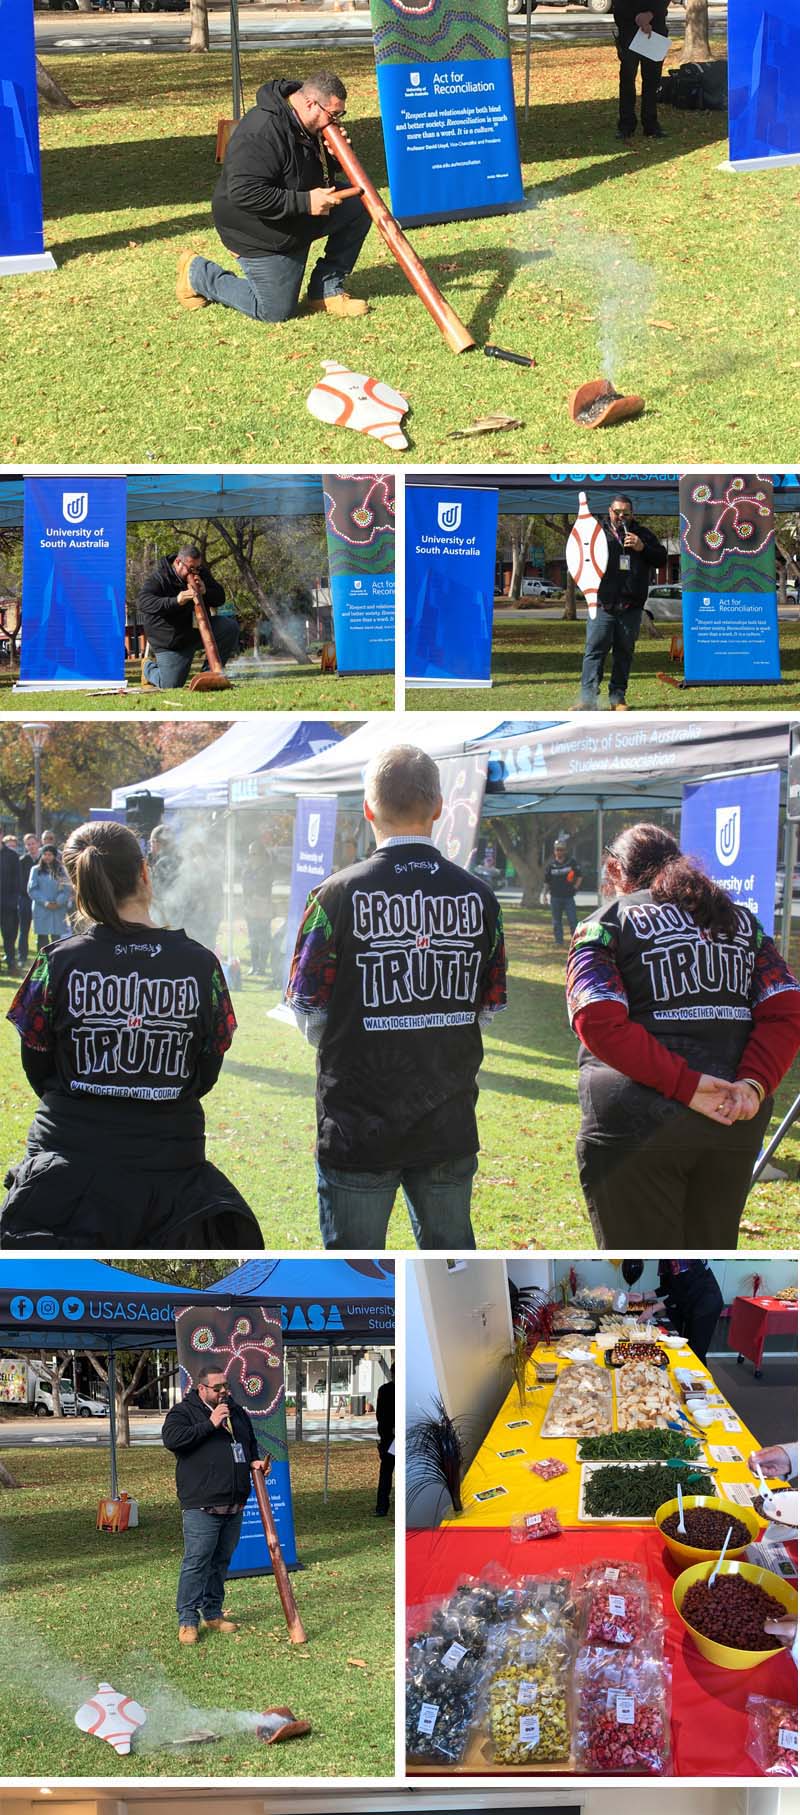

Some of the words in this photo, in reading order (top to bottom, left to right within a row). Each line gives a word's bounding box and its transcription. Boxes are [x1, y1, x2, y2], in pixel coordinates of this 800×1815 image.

[433, 73, 449, 83] Act
[451, 72, 464, 82] for
[434, 81, 495, 94] Reconciliation
[428, 110, 438, 118] and
[439, 107, 474, 117] relationships
[475, 106, 488, 114] both
[396, 122, 406, 131] and
[407, 121, 424, 130] better
[447, 117, 486, 126] Reconciliation
[422, 130, 436, 138] than
[440, 128, 456, 138] word.
[46, 528, 91, 538] University
[94, 528, 104, 536] of
[40, 540, 66, 548] South
[69, 540, 109, 548] Australia
[421, 536, 464, 545] University
[466, 537, 476, 545] of
[416, 546, 440, 554] South
[443, 547, 480, 555] Australia
[551, 736, 600, 754] University
[602, 734, 612, 748] of
[615, 730, 647, 748] South
[650, 724, 702, 745] Australia
[569, 759, 610, 774] Student
[610, 752, 676, 769] Association
[300, 852, 318, 864] University
[296, 863, 308, 872] South
[309, 865, 325, 876] Australia
[710, 875, 742, 894] iversity
[744, 875, 755, 890] of
[352, 890, 484, 940] GROUNDED
[626, 903, 752, 939] GROUD
[416, 934, 430, 949] in
[356, 949, 481, 1007] TRUTH
[642, 942, 754, 1001] TRUTH
[68, 970, 200, 1018] GROUNDED
[654, 1010, 678, 1020] WALK
[679, 1006, 714, 1020] TOGETHER
[716, 1006, 734, 1020] WITH
[127, 1014, 142, 1028] in
[364, 1017, 388, 1030] WALK
[390, 1014, 425, 1028] TOGETHER
[426, 1014, 445, 1027] WITH
[446, 1012, 476, 1025] COURAGE
[72, 1027, 193, 1078] TRUTH
[92, 1084, 129, 1098] TOGETHER
[131, 1086, 151, 1099] WITH
